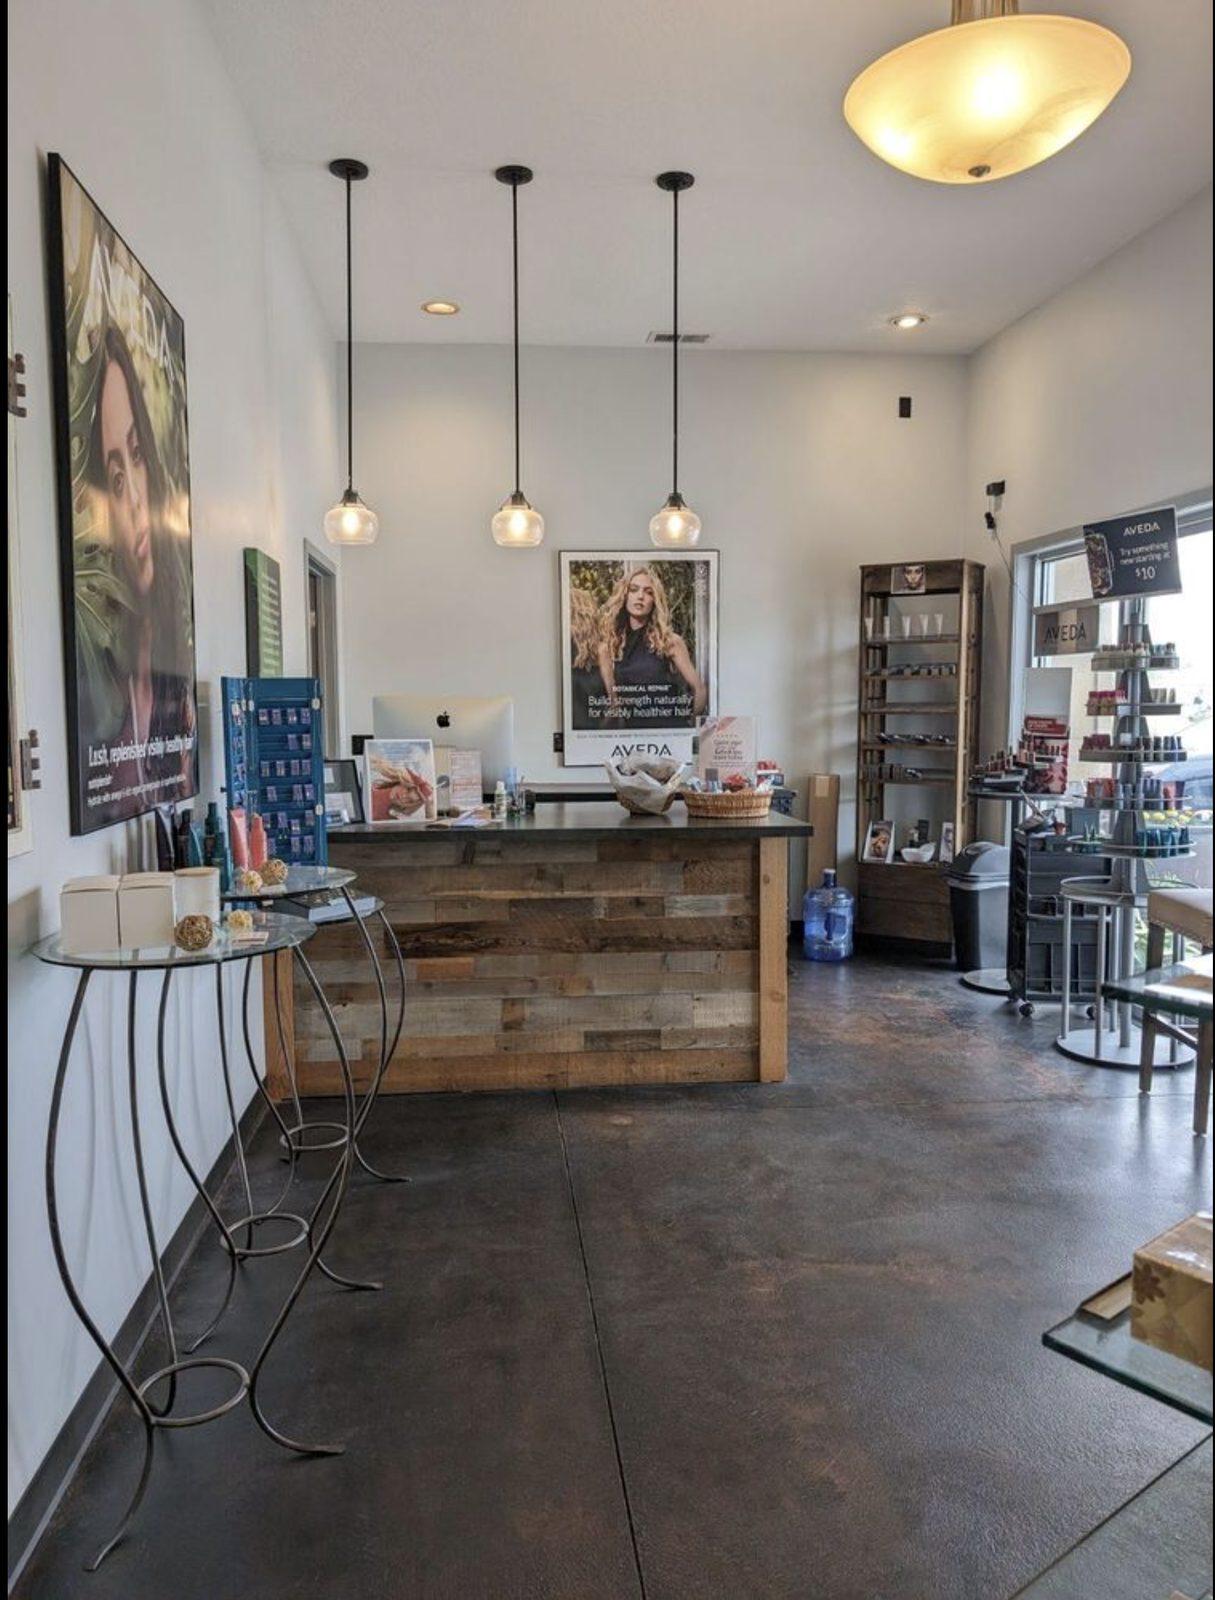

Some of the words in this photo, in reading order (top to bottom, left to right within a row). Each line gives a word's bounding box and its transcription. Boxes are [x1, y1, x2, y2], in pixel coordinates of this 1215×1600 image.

[1123, 522, 1161, 536] AVEDA
[1044, 622, 1087, 642] AVEDA
[588, 695, 612, 707] Build
[613, 694, 652, 708] strength
[653, 693, 694, 706] naturally
[588, 708, 601, 717] for
[602, 707, 631, 719] visibly
[633, 706, 673, 718] healthier
[611, 743, 672, 757] AVEDA
